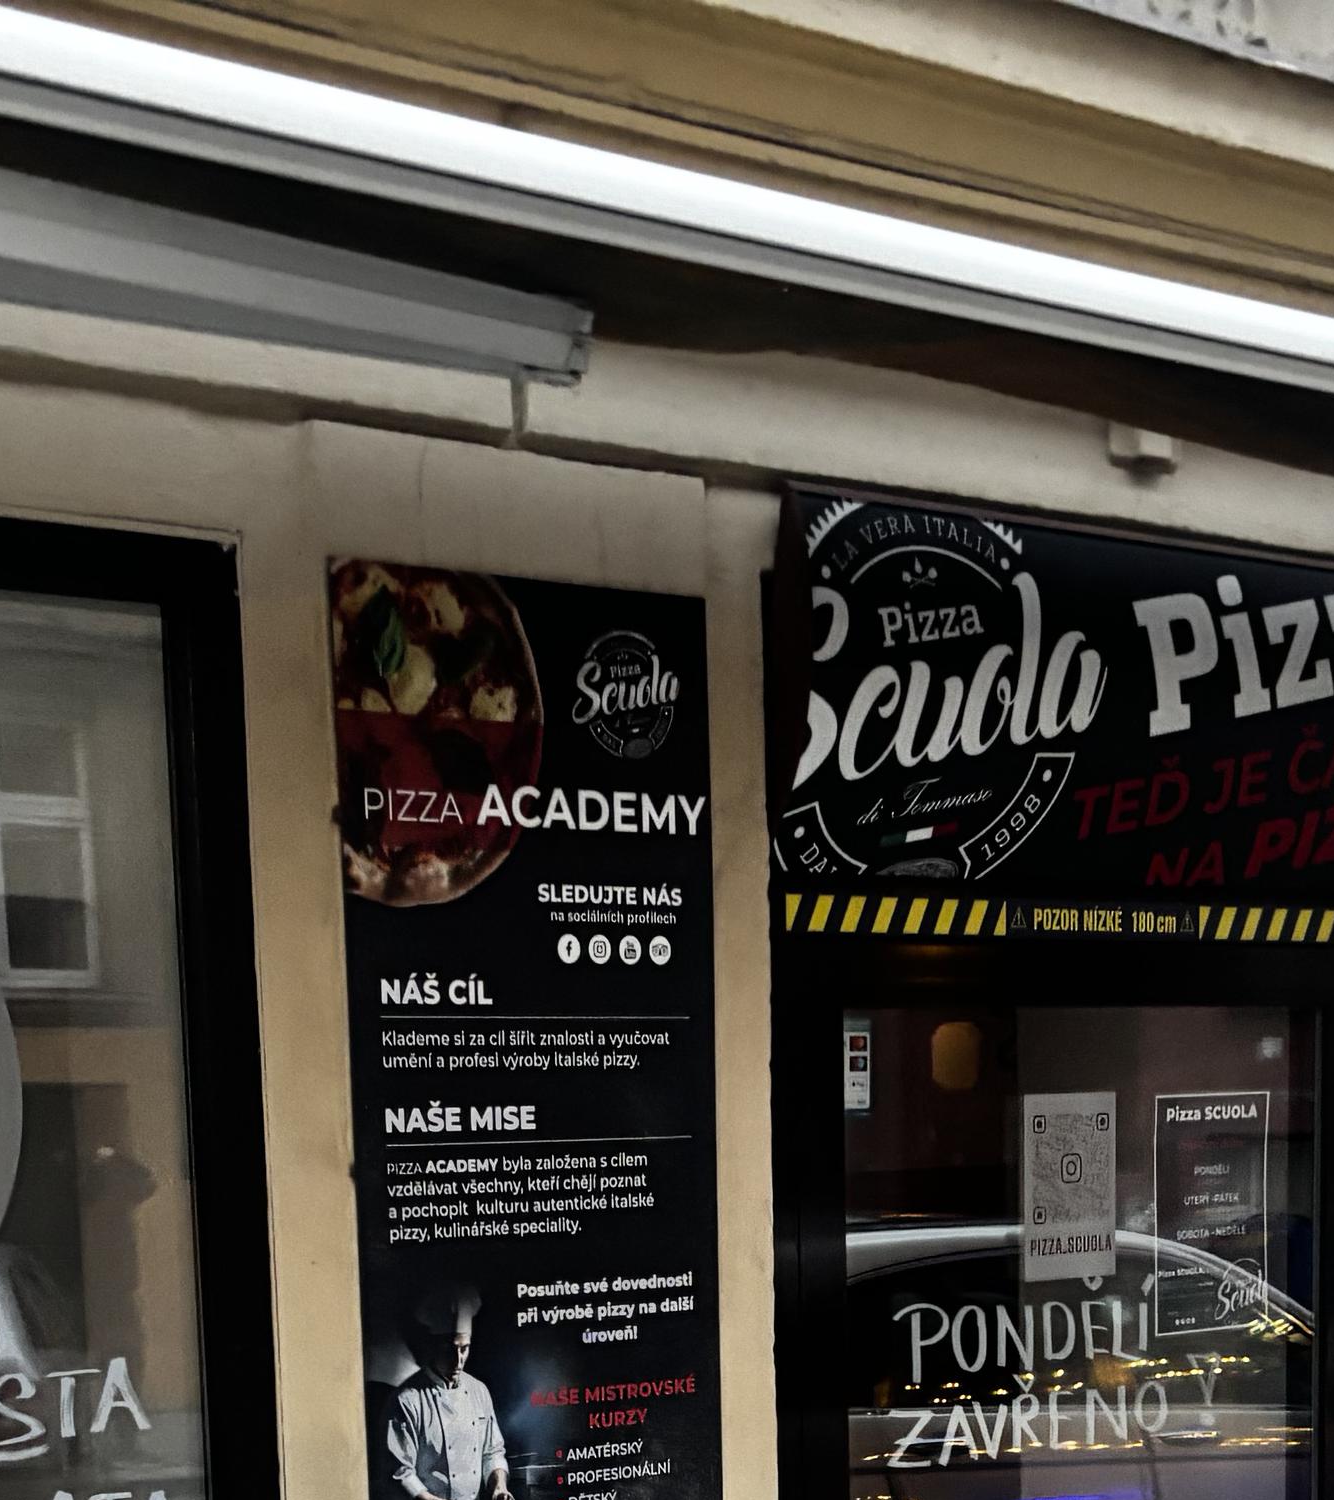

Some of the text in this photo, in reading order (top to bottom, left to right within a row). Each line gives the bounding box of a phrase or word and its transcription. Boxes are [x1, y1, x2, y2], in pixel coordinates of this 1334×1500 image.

[878, 601, 984, 647] Pizza
[572, 654, 679, 724] Scuola
[364, 784, 706, 835] PIZZA ACADEMY
[1075, 756, 1190, 840] TEĎ
[1204, 751, 1271, 814] JE
[981, 794, 1041, 861] 1998
[1146, 841, 1224, 887] NA
[538, 883, 682, 906] SLEDUJTE NÁS
[1034, 905, 1176, 933] POZOR NÍZKÉ 180 cm
[380, 972, 493, 1005] NÁŠ CÍL
[382, 1031, 449, 1047] Klademe
[454, 1031, 465, 1046] si
[469, 1033, 485, 1046] za
[539, 1031, 594, 1046] znalosti
[598, 1033, 606, 1046] a
[609, 1030, 669, 1048] vyučovat
[383, 1052, 432, 1069] umění
[436, 1056, 445, 1068] a
[449, 1052, 499, 1070] profesi
[503, 1052, 550, 1070] výroby
[603, 1053, 640, 1069] pizzy.
[385, 1101, 536, 1132] NAŠE MISE
[1166, 1103, 1258, 1122] Pizza SCUOLA
[387, 1152, 648, 1175] PIZZA ACADEMY byla založena s cílem
[389, 1194, 654, 1221] a pochopit kulturu autentické italské
[389, 1218, 581, 1243] pizzy, kulinářské speciality.
[518, 1271, 692, 1299] Posuňte své dovednosti
[518, 1296, 694, 1327] při výrobě pizzy na další
[892, 1274, 1154, 1384] PONDĚLÍ
[531, 1374, 695, 1406] NAŠE MISTROVSKÉ
[589, 1408, 648, 1429] KURZY
[887, 1375, 1167, 1467] ZAVŘENO
[567, 1438, 643, 1461] AMATÉRSKÝ
[568, 1459, 671, 1484] PROFESIONÁLNÍ
